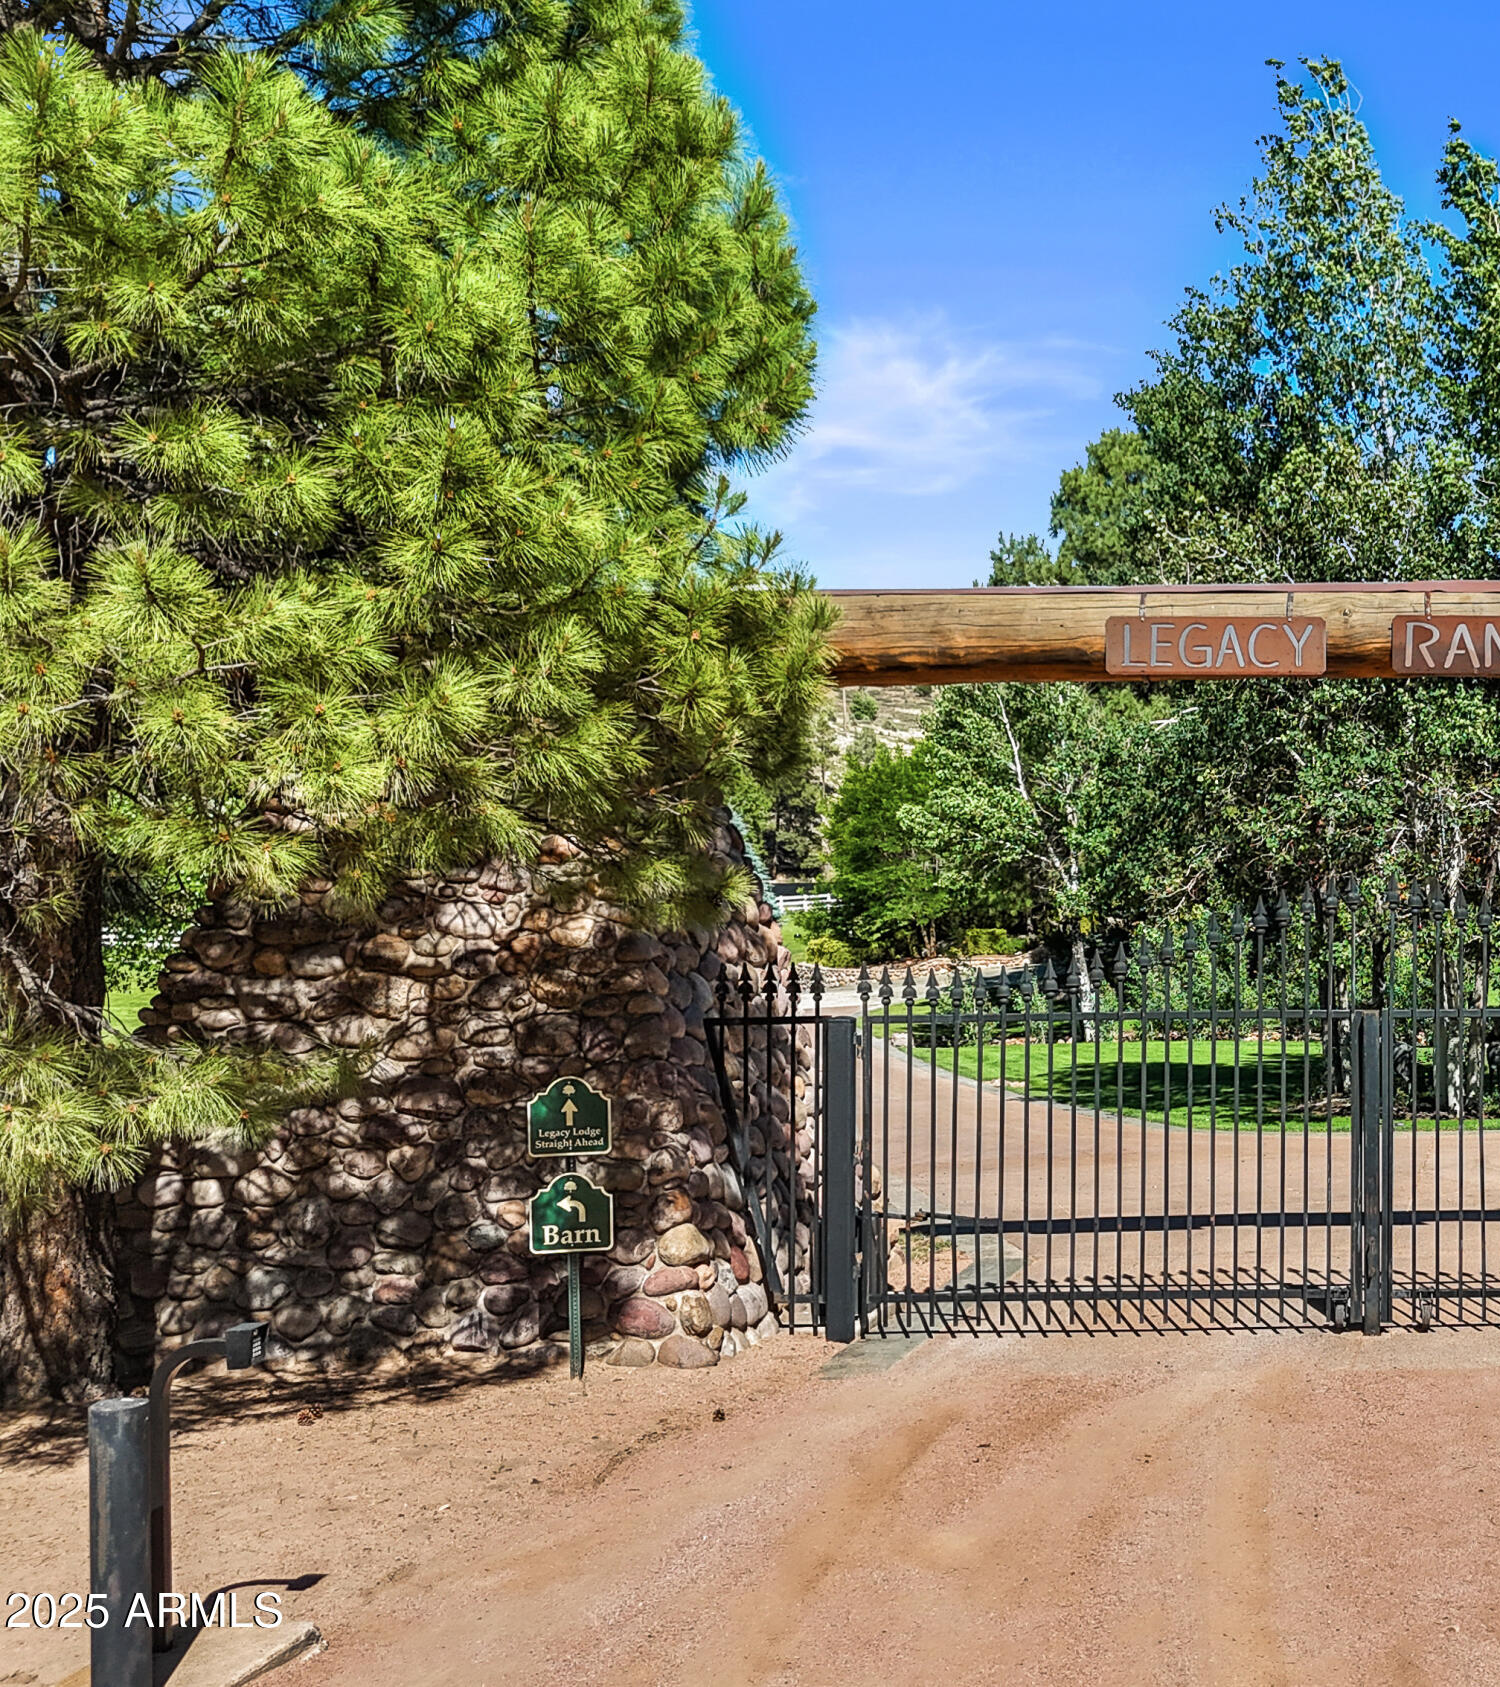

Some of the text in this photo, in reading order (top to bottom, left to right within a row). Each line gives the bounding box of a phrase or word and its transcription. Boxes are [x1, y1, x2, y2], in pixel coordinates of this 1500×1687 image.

[1120, 624, 1313, 669] LEGACY
[538, 1127, 601, 1140] Legacy Lodge
[535, 1137, 604, 1150] Straight Ahead
[542, 1224, 601, 1246] Barn
